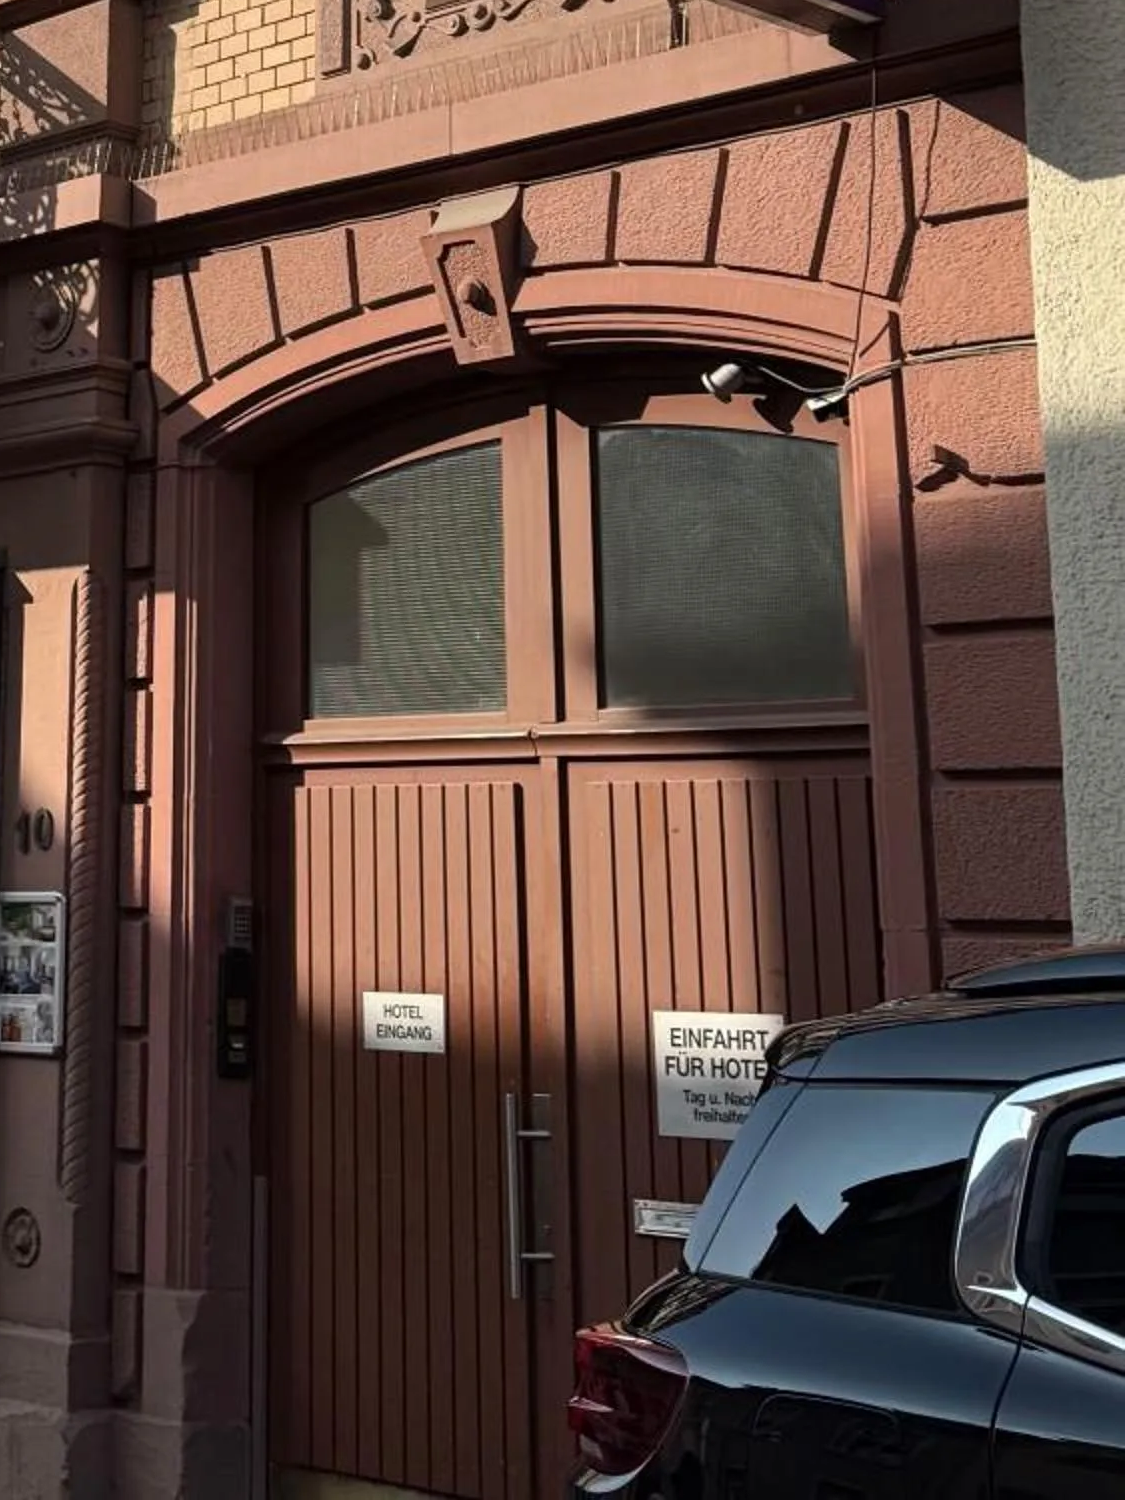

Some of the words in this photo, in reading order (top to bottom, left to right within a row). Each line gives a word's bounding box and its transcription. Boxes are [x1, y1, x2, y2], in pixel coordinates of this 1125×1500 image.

[15, 807, 55, 855] 10
[383, 1003, 423, 1019] HOTEL
[377, 1023, 432, 1041] EINGANG
[670, 1027, 770, 1050] EINFAHRT
[664, 1051, 705, 1077] FÜR
[711, 1057, 768, 1079] HOTE
[682, 1089, 706, 1107] Tag
[709, 1093, 722, 1105] u.
